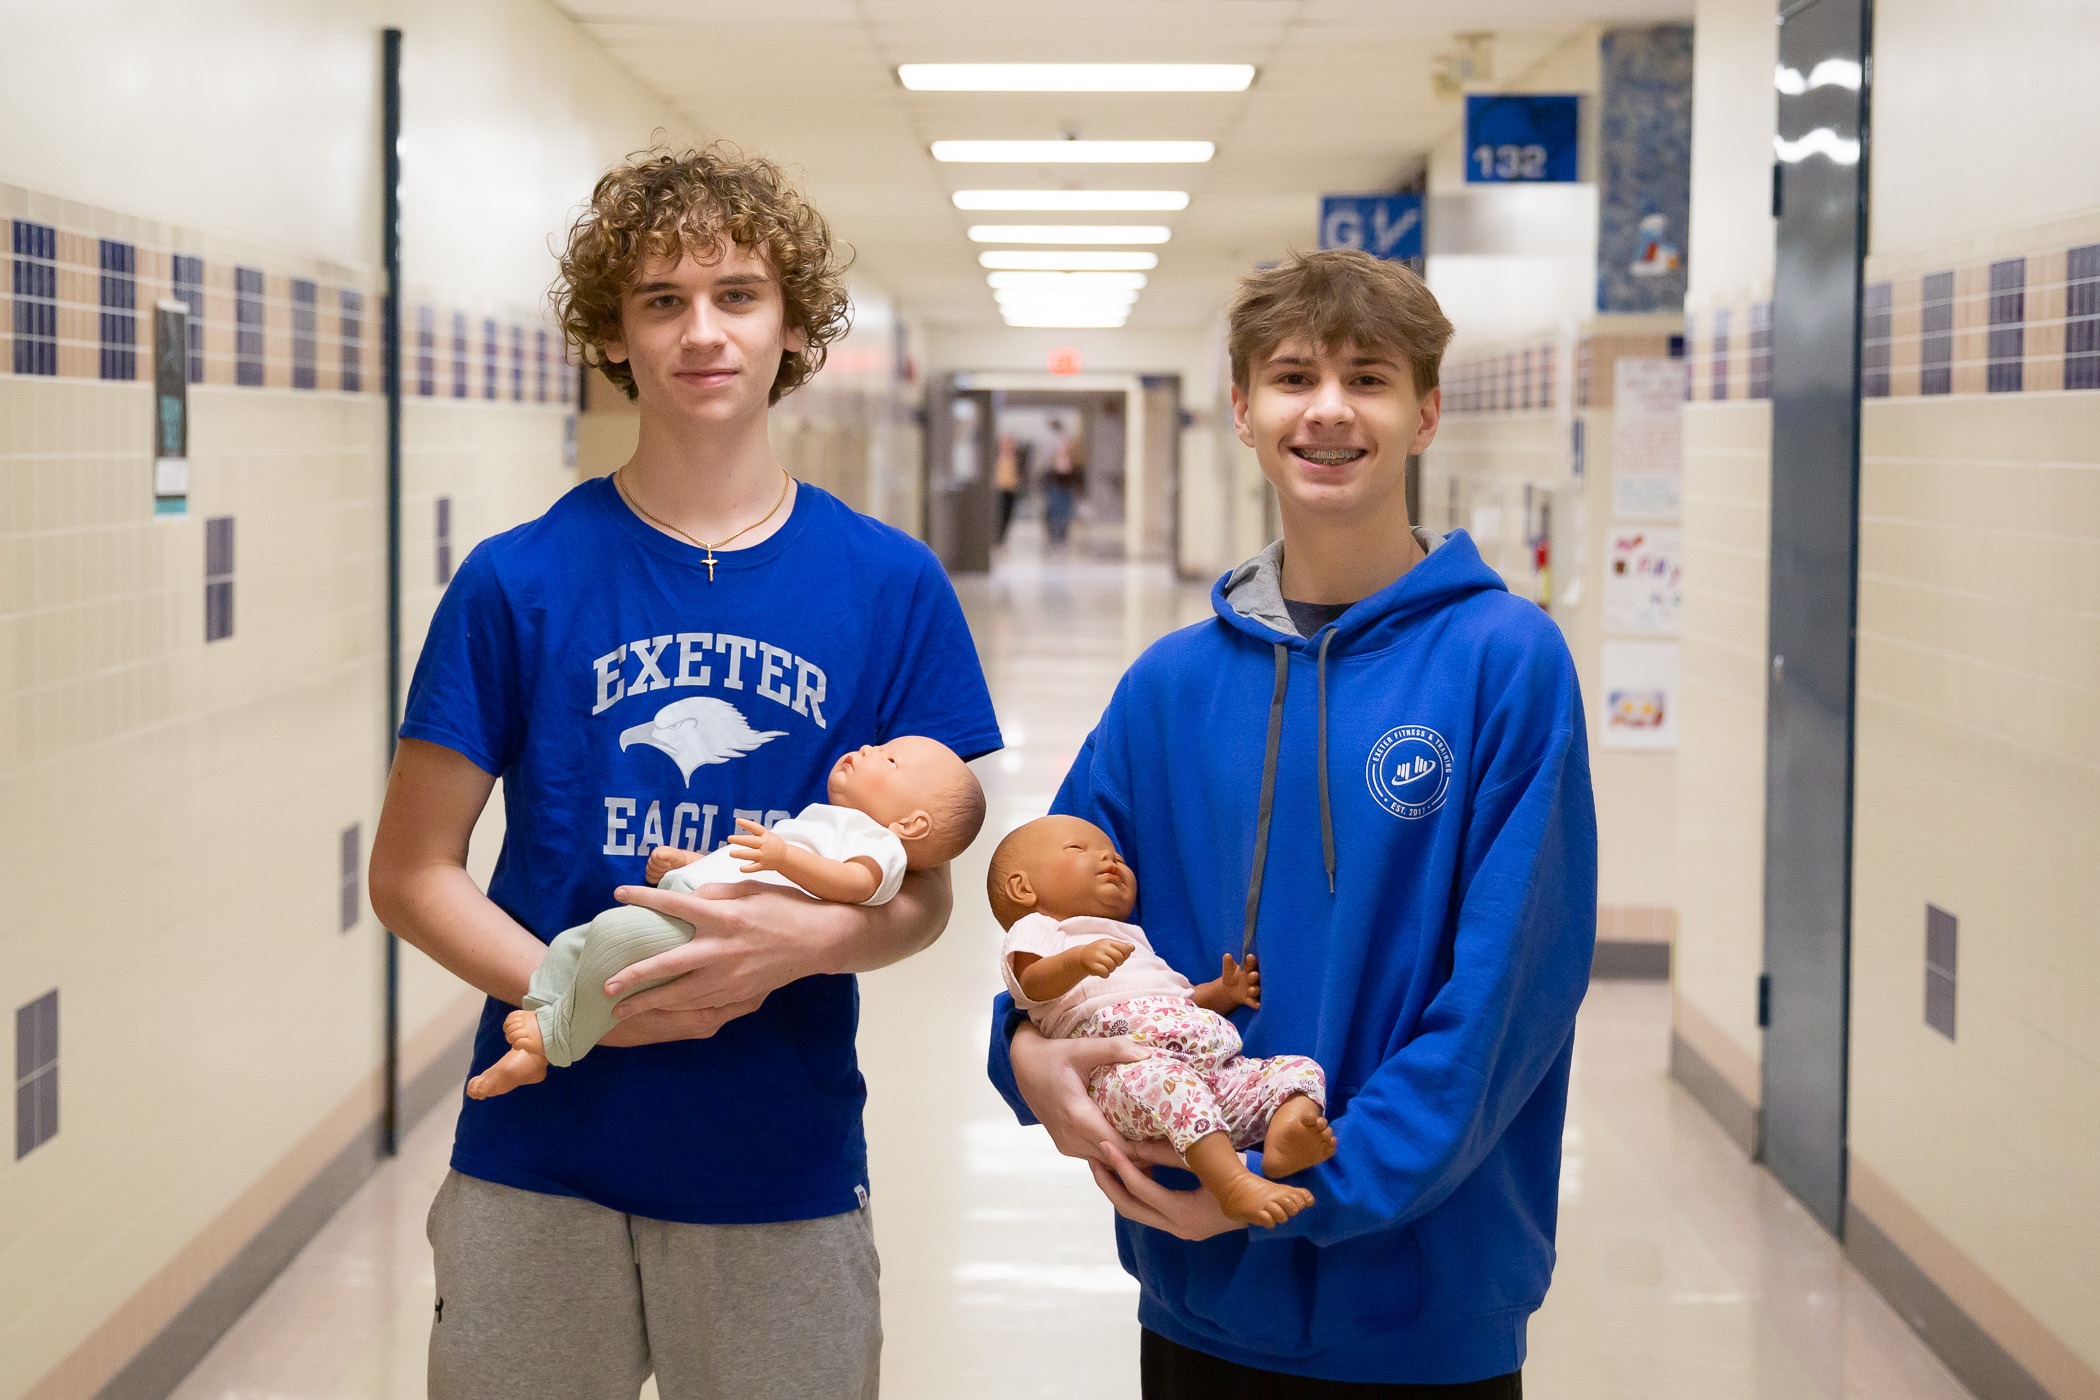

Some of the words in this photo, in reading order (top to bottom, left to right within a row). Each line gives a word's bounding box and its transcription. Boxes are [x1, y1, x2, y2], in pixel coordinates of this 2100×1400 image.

[1473, 144, 1547, 179] 132
[592, 632, 827, 729] EXETER
[1373, 737, 1393, 761] EXETER
[1394, 729, 1425, 739] FITNESS
[1435, 740, 1451, 772] TRAINING
[603, 797, 791, 856] EAGL
[1391, 802, 1405, 814] EST.
[1408, 807, 1426, 816] 2017
